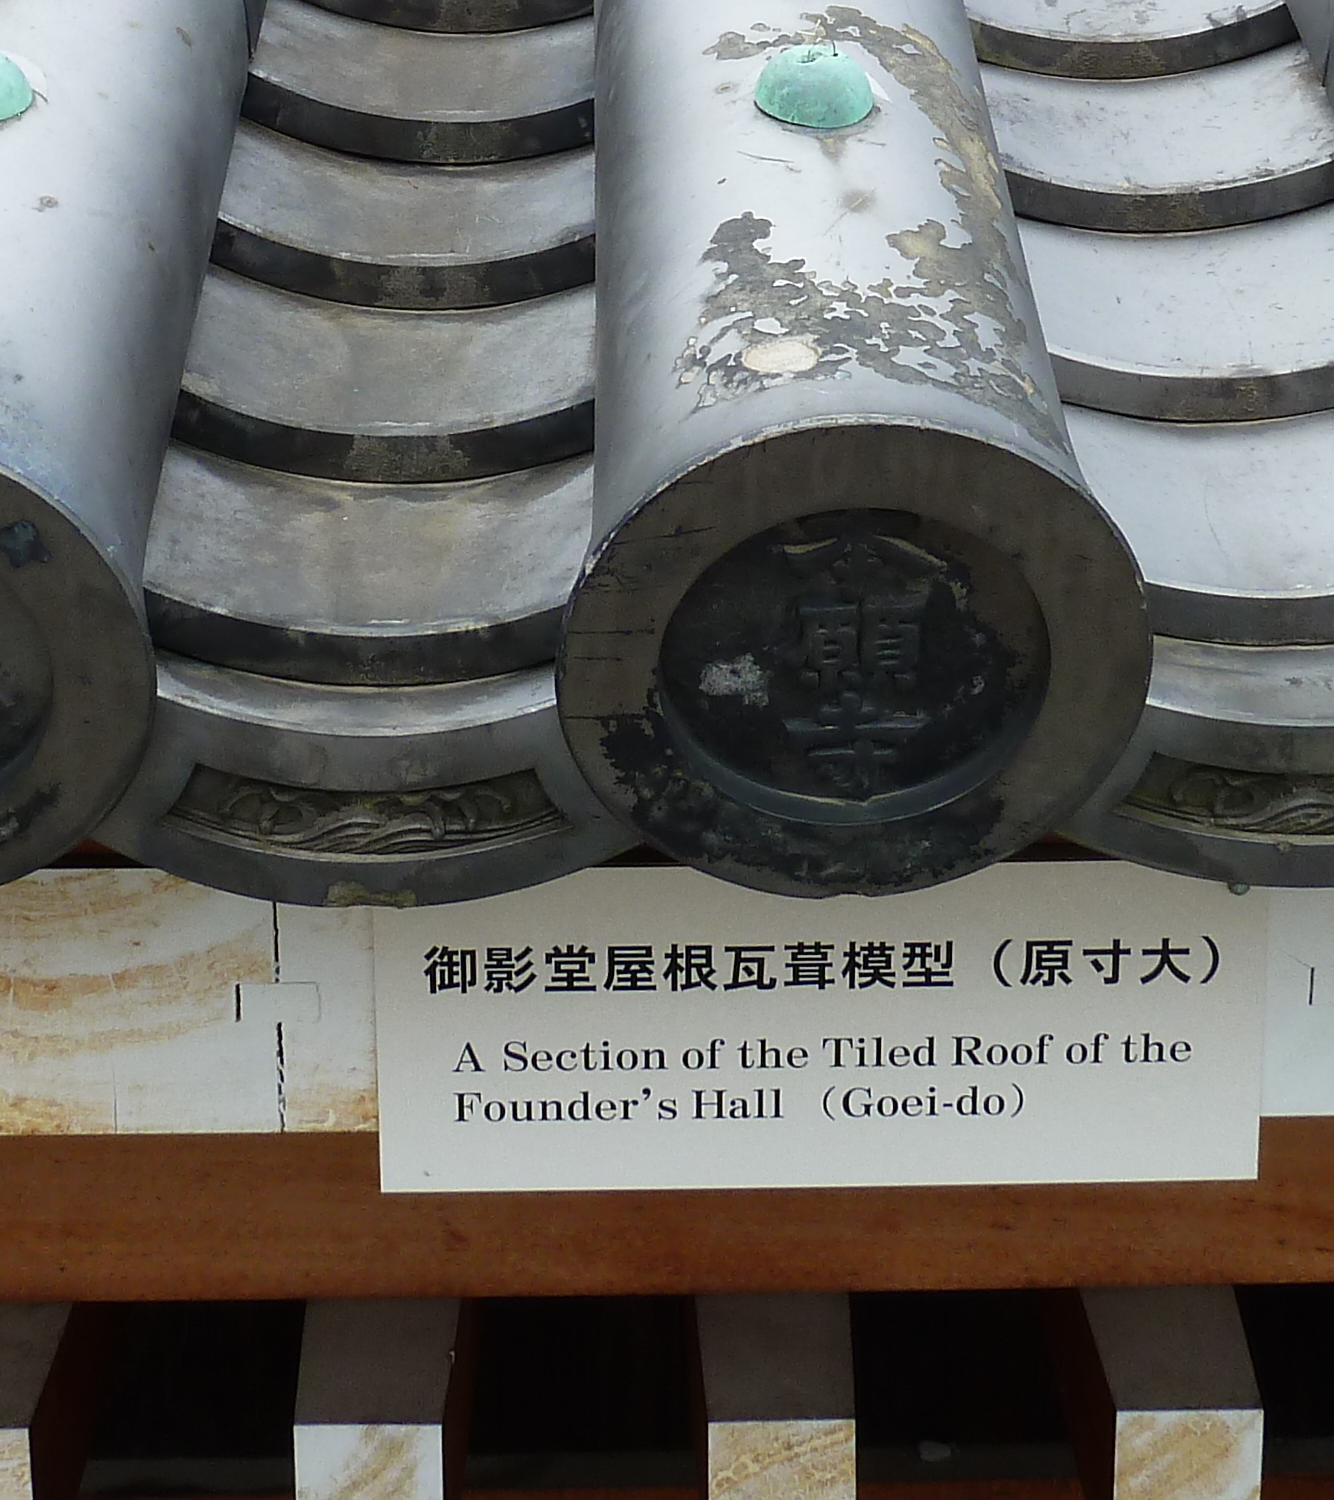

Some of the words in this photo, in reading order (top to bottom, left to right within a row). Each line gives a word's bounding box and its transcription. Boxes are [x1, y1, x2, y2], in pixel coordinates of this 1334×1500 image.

[452, 1041, 486, 1073] A
[503, 1040, 669, 1072] Section
[682, 1038, 726, 1070] of
[736, 1038, 809, 1070] the
[822, 1035, 937, 1068] Tiled
[951, 1033, 1055, 1067] Roof
[1065, 1032, 1110, 1065] of
[1120, 1032, 1192, 1064] the
[453, 1087, 678, 1123] Founder's
[691, 1088, 784, 1120] Hall
[822, 1083, 1024, 1121] (Goei-do)
